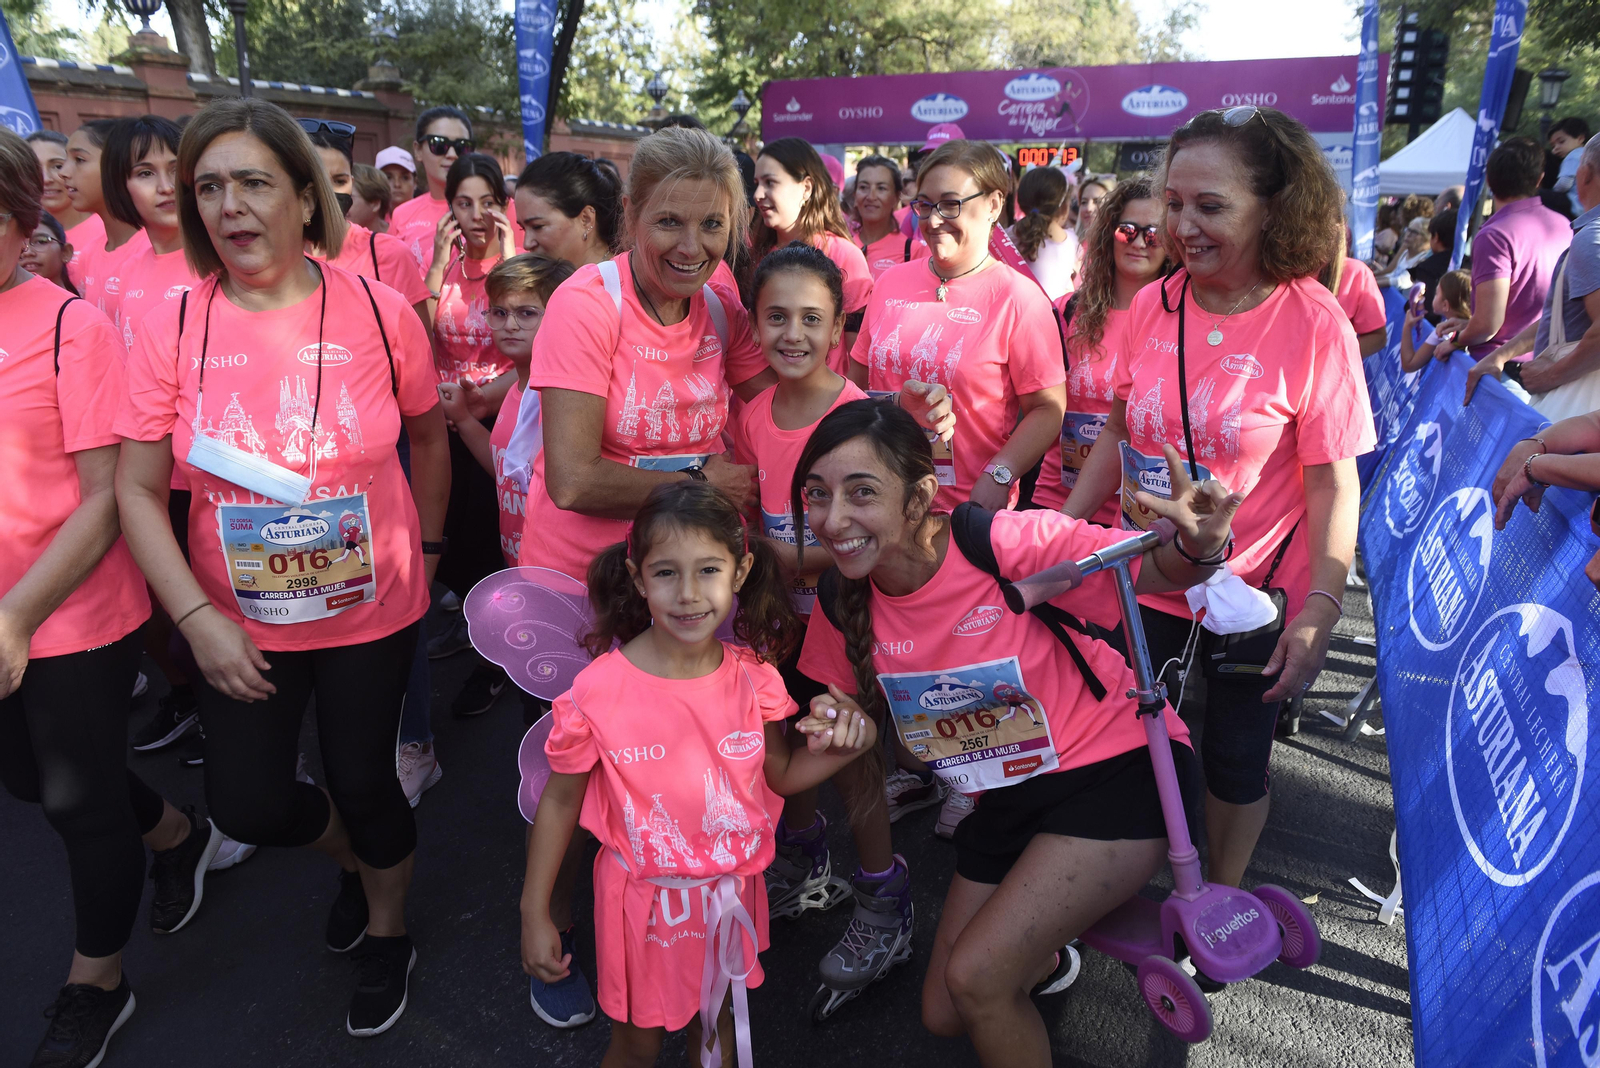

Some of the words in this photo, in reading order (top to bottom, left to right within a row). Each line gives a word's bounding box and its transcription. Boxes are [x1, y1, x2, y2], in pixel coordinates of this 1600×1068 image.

[1009, 83, 1057, 96] ASTURIANA
[1125, 94, 1184, 109] ASTURIANA
[1221, 92, 1277, 106] OYSHO
[773, 112, 813, 122] Santander
[838, 106, 883, 120] OYSHO
[915, 104, 965, 117] ASTURIANA
[1024, 113, 1063, 137] Mujer
[885, 298, 920, 310] OYSHO
[632, 345, 669, 361] SHO
[230, 522, 253, 531] SUMA
[265, 525, 325, 540] ASTURIANA
[268, 548, 330, 575] 016
[286, 576, 318, 589] 2998
[1419, 511, 1468, 639] ASTURIANA
[260, 590, 295, 600] CARRERA
[296, 589, 307, 598] DE
[309, 588, 319, 596] LA
[323, 582, 346, 593] MUJER
[337, 594, 360, 605] Santander
[249, 604, 289, 617] OYSHO
[957, 612, 1001, 634] ASTURIANA
[924, 692, 982, 708] ASTURIANA
[935, 708, 997, 739] 016
[1499, 643, 1532, 714] CENTRAL
[1526, 706, 1568, 799] LECHERA
[722, 737, 762, 755] ASTURIANA
[960, 735, 989, 752] 2567
[1459, 630, 1548, 870] ASTURIANA
[606, 744, 666, 765] YSHO
[936, 753, 971, 769] CARRERA
[972, 751, 983, 761] DE
[984, 749, 995, 759] LA
[995, 744, 1021, 756] MUJER
[1014, 761, 1038, 771] Santander
[678, 929, 690, 939] LA
[1200, 908, 1260, 949] juguettos
